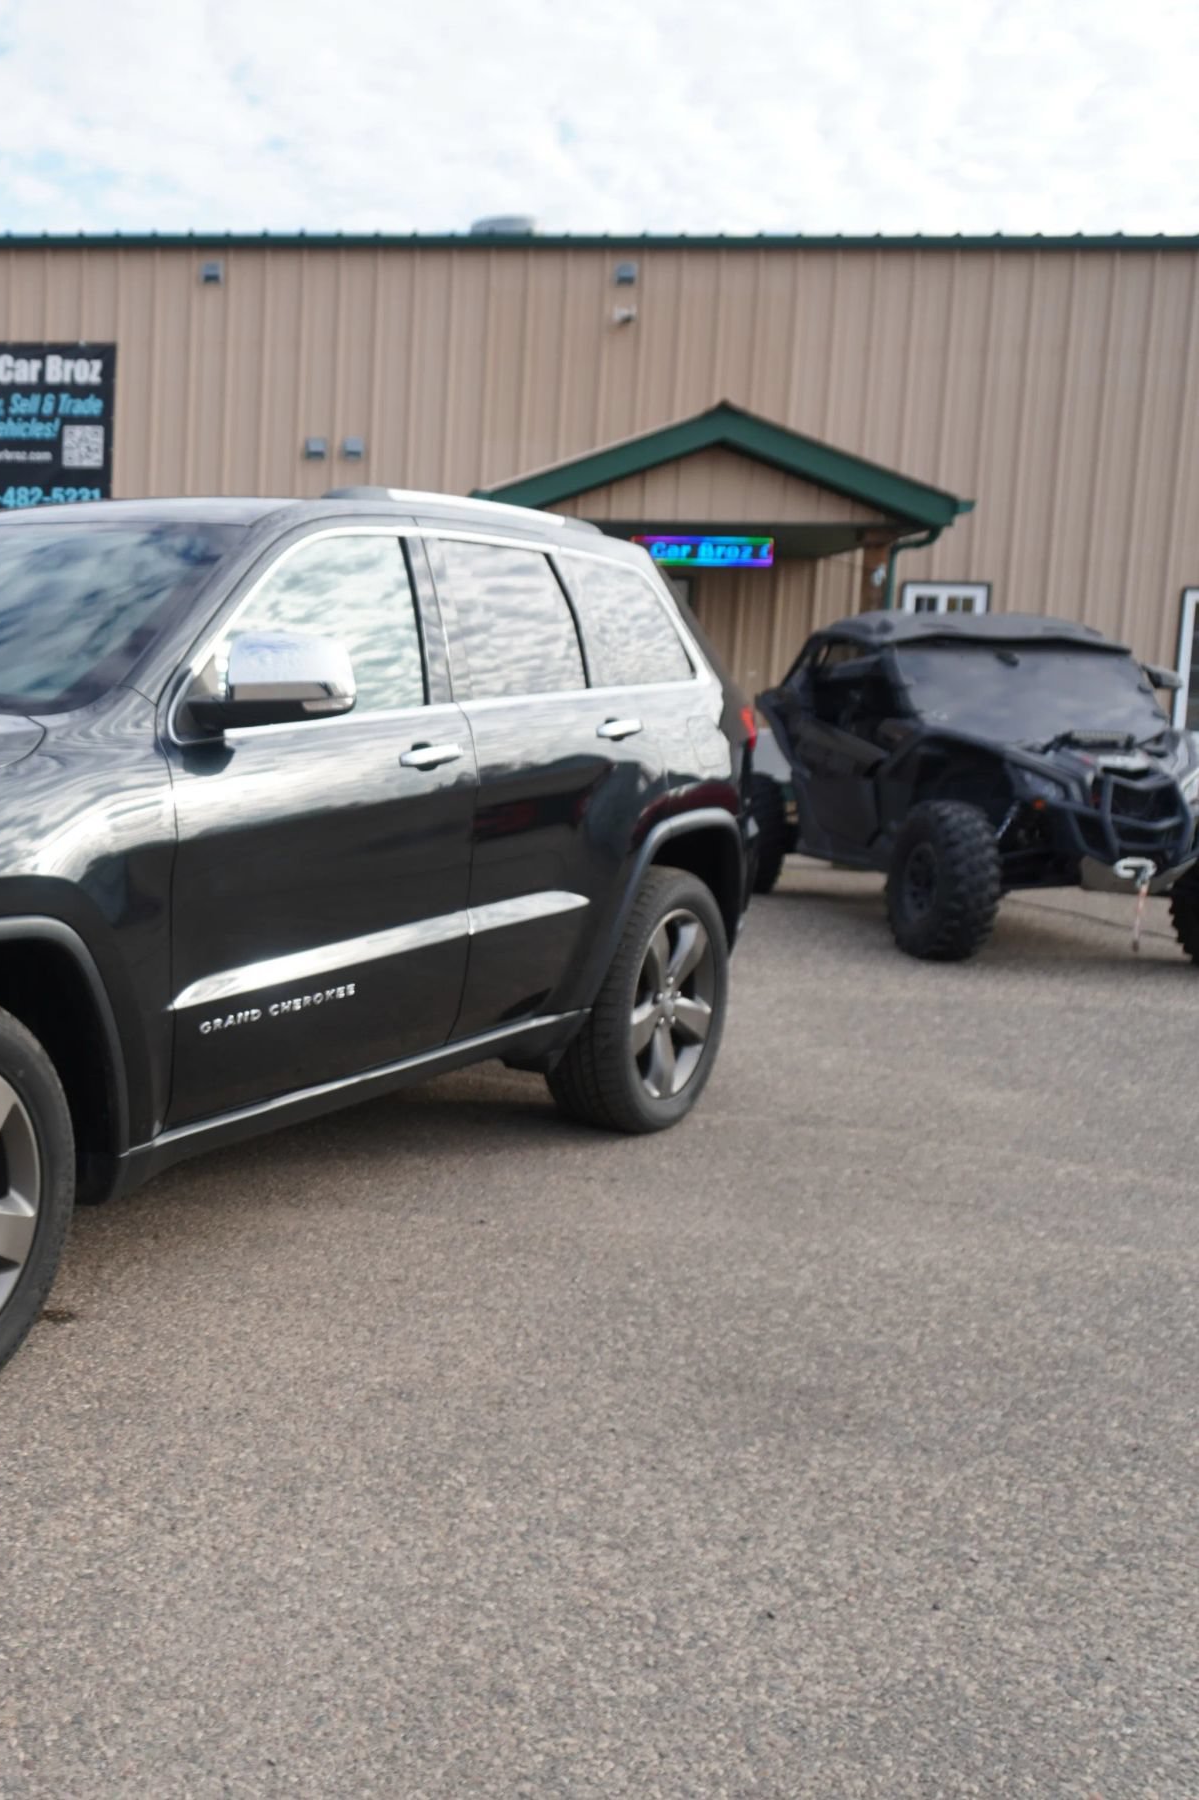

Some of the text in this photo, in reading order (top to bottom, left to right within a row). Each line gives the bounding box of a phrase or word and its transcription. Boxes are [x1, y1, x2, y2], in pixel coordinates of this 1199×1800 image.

[45, 354, 103, 384] Broz
[9, 393, 41, 415] Sell
[42, 393, 56, 415] &
[59, 393, 103, 415] Trade
[651, 542, 691, 558] Car
[698, 542, 753, 558] Broz
[199, 983, 356, 1034] GRAND CHEROKEE
